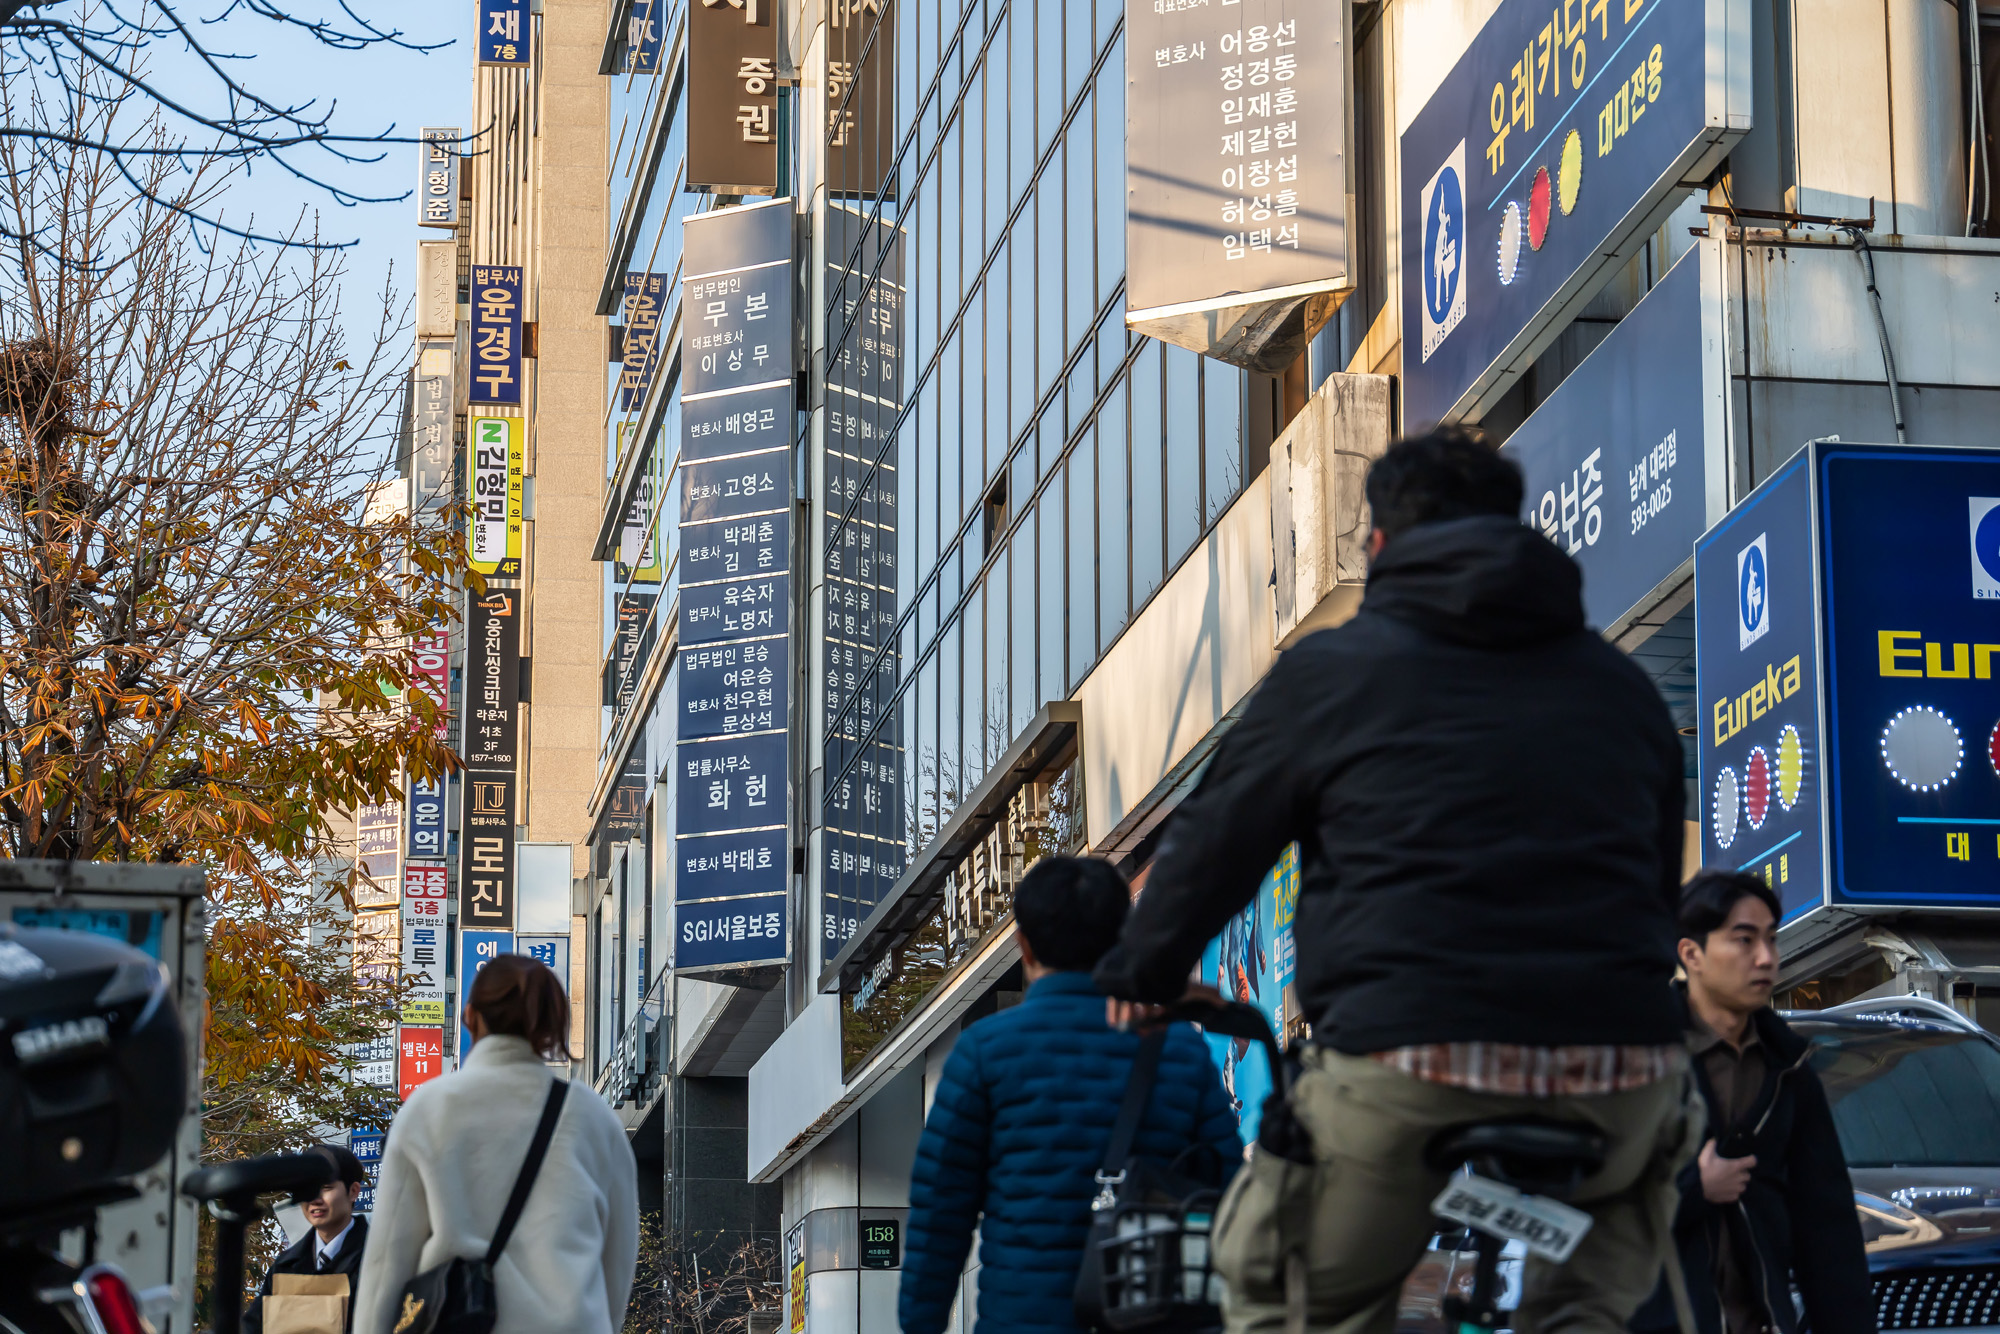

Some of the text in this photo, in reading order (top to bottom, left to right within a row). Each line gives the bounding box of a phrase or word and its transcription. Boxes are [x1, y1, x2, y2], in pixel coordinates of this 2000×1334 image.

[488, 0, 520, 42] 재
[493, 44, 517, 60] 7층
[1155, 19, 1297, 67] 변호사 어용선
[1220, 53, 1298, 91] 정경동
[1487, 0, 1644, 175] 유레카당
[1599, 43, 1663, 158] 대대전용
[1221, 87, 1298, 124] 임재훈
[1220, 121, 1297, 156] 제갈헌
[1221, 155, 1298, 189] 이창섭
[1221, 189, 1299, 224] 허성흠
[1222, 223, 1299, 260] 임택석
[434, 250, 451, 323] 정신건강
[476, 269, 520, 286] 법무사
[693, 277, 741, 300] 법무법인
[476, 288, 516, 397] 윤경구
[692, 329, 744, 350] 대표변호사
[426, 380, 444, 464] 법무법인
[691, 408, 776, 438] 변호사 배영곤
[1650, 428, 1677, 480] 대리점
[476, 447, 506, 522] 김형민
[690, 472, 775, 500] 변호사 고영소
[1631, 478, 1672, 535] 593-0025
[475, 524, 486, 553] 변호사
[689, 521, 774, 563] 변호사 박래춘
[502, 562, 519, 574] 4F
[689, 582, 774, 622] 법무사 육숙자
[722, 608, 774, 631] 노명자
[484, 618, 503, 709] 웅진씽크빅
[686, 644, 769, 671] 법무법인 문승
[723, 666, 774, 688] 여운승
[477, 709, 508, 721] 라운지
[688, 688, 772, 713] 변호사 천우현
[1714, 655, 1801, 748] Eureka
[480, 726, 502, 738] 서초
[722, 710, 772, 733] 문상석
[471, 754, 511, 763] 1577-1500
[484, 742, 499, 751] 3F
[687, 754, 751, 778] 법률사무소
[471, 817, 507, 826] 법률사무소
[687, 848, 773, 873] 변호사 박태호
[406, 870, 446, 897] 공증
[471, 837, 505, 917] 로진
[406, 918, 444, 926] 법무법인
[414, 901, 439, 915] 5층
[683, 912, 781, 943] SGI서울보증
[412, 929, 436, 987] 로투스
[403, 1042, 440, 1057] 밸런스
[415, 1061, 428, 1073] 11
[865, 1226, 894, 1242] 158
